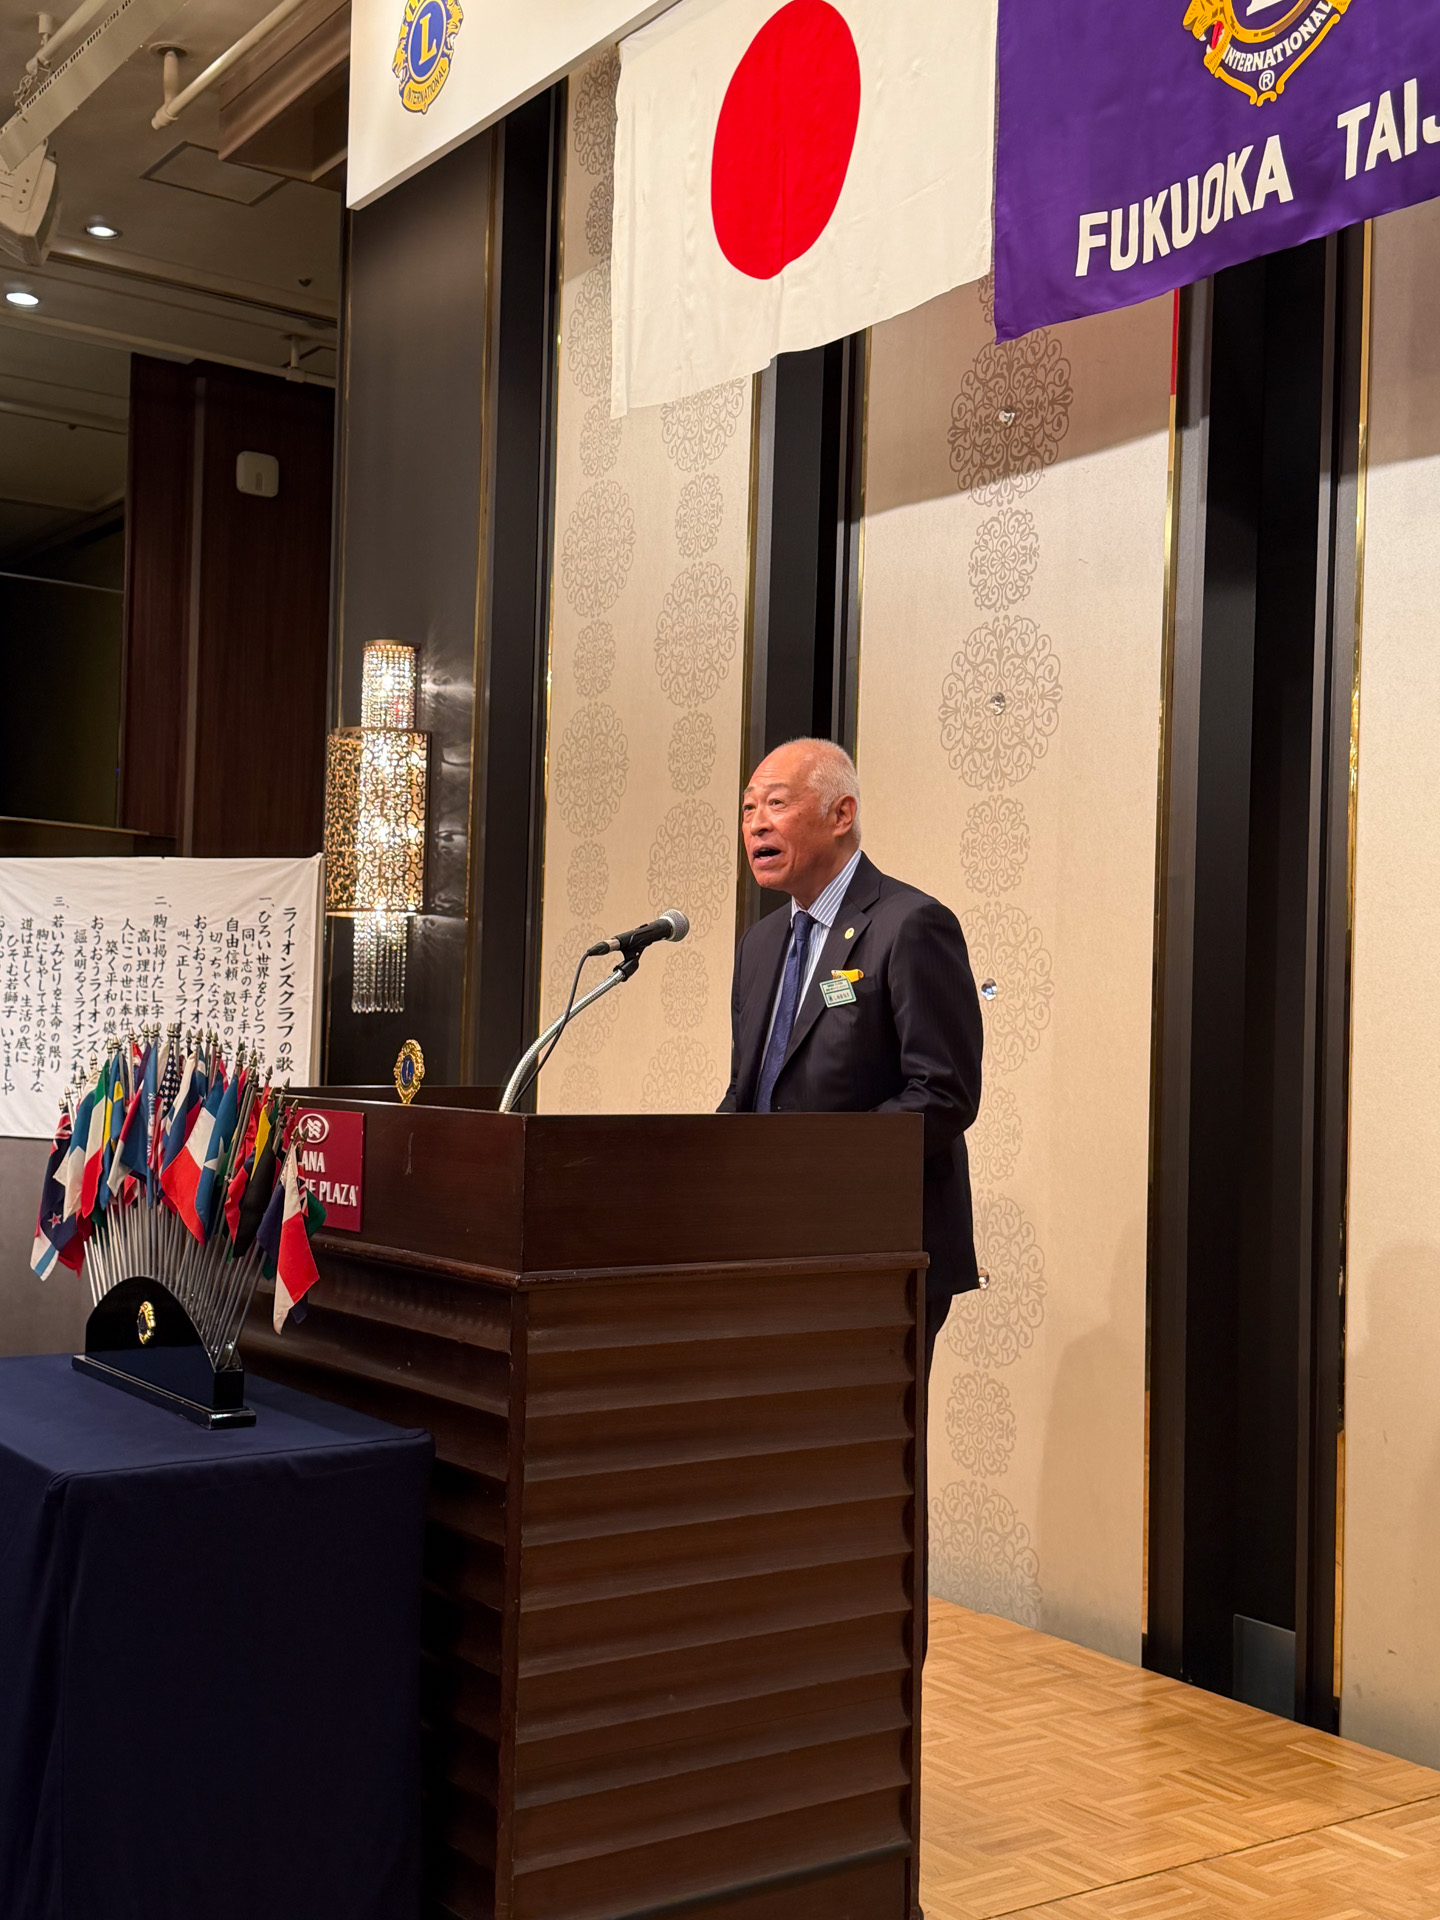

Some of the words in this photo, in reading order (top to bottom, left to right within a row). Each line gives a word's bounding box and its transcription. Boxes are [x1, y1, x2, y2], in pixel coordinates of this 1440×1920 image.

[1222, 1, 1333, 72] INTERNATIONAL
[1075, 134, 1294, 277] FUKUOKA
[87, 915, 104, 1053] おうおうライオンズ
[276, 907, 298, 1073] ライオンズクラブの歌
[301, 1150, 326, 1173] ANA
